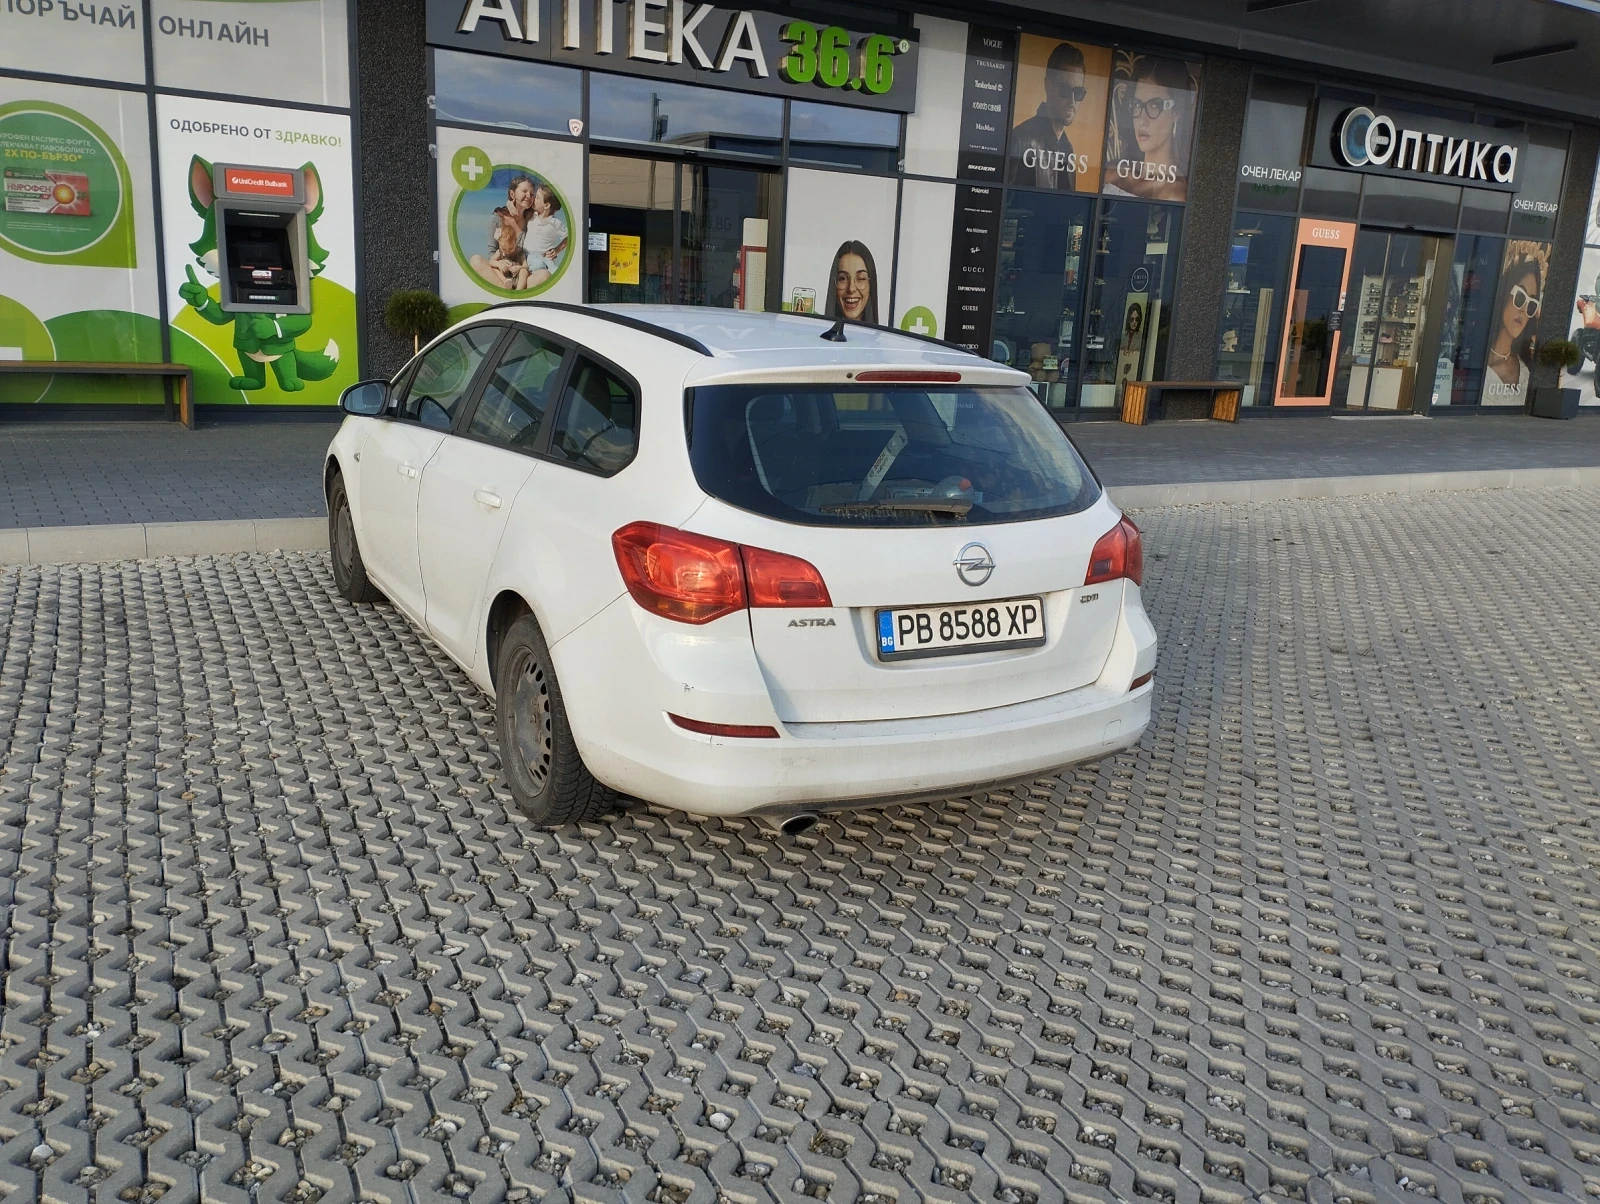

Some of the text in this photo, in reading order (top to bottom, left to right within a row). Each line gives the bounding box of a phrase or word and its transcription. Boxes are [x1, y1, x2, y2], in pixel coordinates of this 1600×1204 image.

[158, 15, 270, 48] ОНЛАЙН
[983, 38, 1003, 49] VOGUE
[169, 118, 342, 148] ОДОБРЕНО ОТ ЗДРАВКО!
[31, 135, 65, 144] ЕКСПРЕС
[66, 138, 92, 147] ФОРТЕ
[1022, 148, 1088, 174] GUESS
[1116, 159, 1177, 183] GUESS
[1241, 164, 1302, 182] ОЧЕН ЛЕКАР
[7, 182, 52, 193] НУРОФЕН
[238, 178, 288, 189] UniCredit Bulbank
[1513, 199, 1559, 214] ОЧЕН ЛЕКАР
[1312, 227, 1341, 240] GUESS
[1488, 383, 1521, 396] GUESS
[787, 617, 836, 628] ASTRA
[897, 604, 1037, 646] PB 8588 XP
[881, 636, 893, 647] BG
